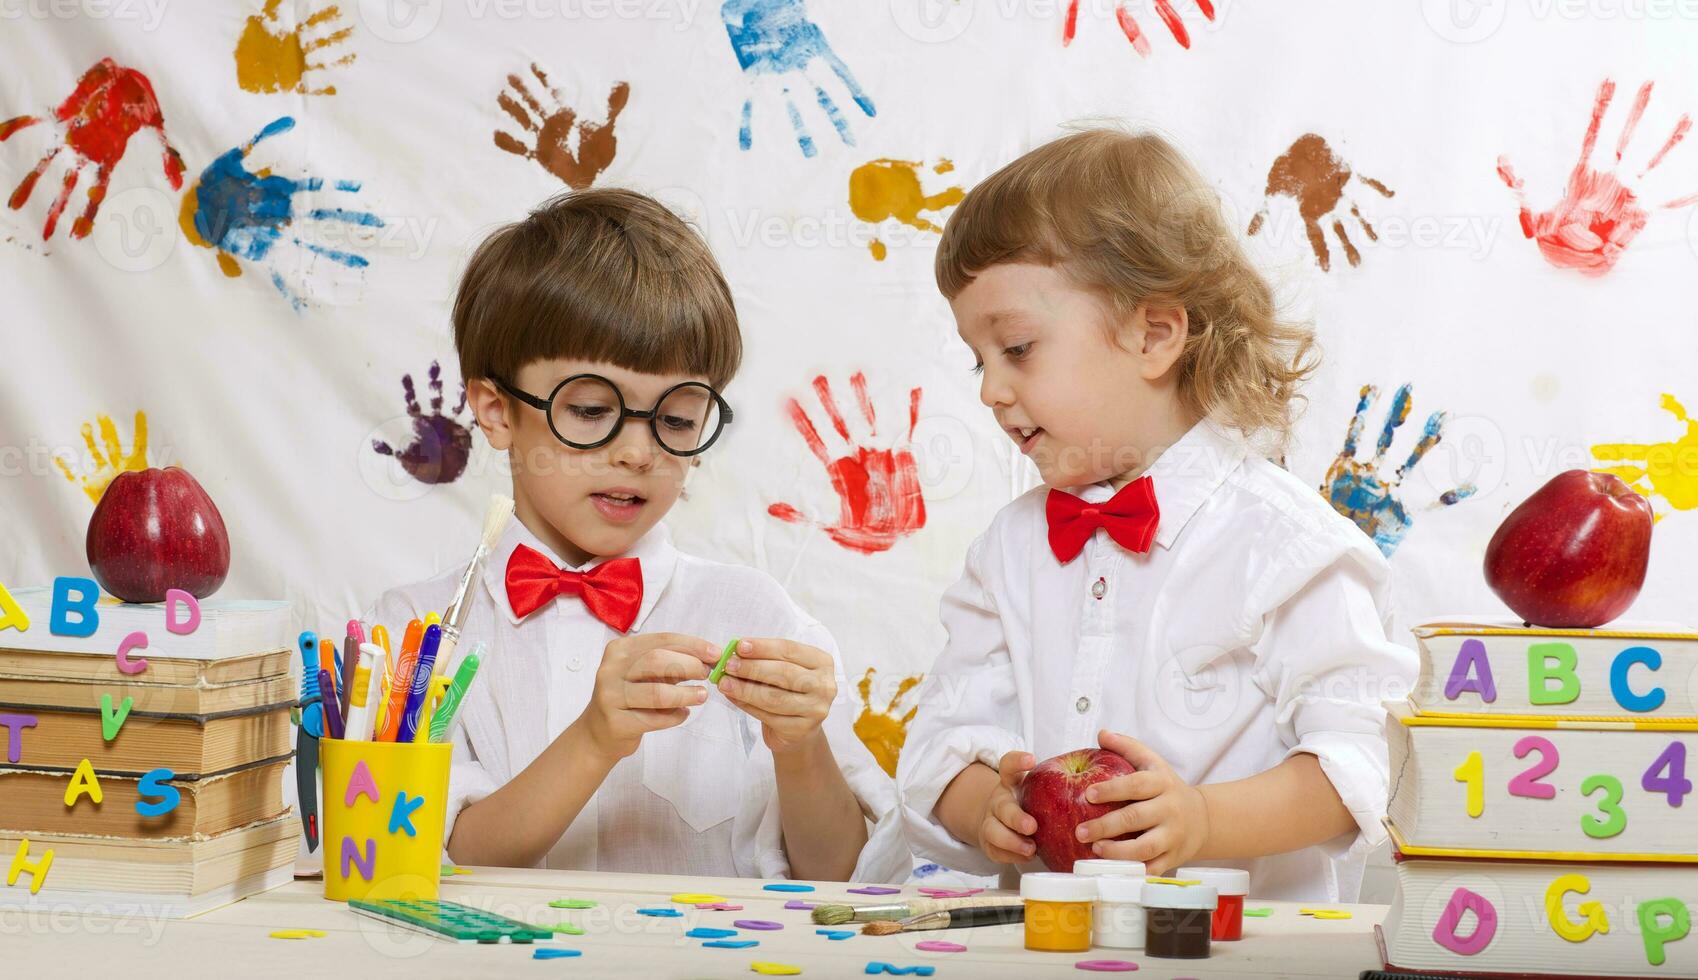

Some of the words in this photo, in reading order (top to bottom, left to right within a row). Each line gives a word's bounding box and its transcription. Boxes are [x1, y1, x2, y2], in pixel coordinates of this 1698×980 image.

[50, 576, 100, 638] B
[165, 588, 202, 636] D
[116, 631, 149, 675] C
[1444, 639, 1497, 703] A
[1527, 642, 1581, 705] B
[1610, 646, 1666, 712] C
[0, 714, 38, 763] T
[101, 693, 133, 742] V
[63, 757, 104, 807] A
[135, 768, 181, 817] S
[345, 760, 380, 807] A
[1453, 751, 1485, 818] 1
[1507, 736, 1560, 800] 2
[1580, 774, 1627, 839] 3
[1641, 740, 1693, 807] 4
[389, 791, 425, 837] K
[7, 838, 55, 894] H
[341, 836, 376, 881] N
[1432, 887, 1498, 956] D
[1545, 872, 1610, 943] G
[1637, 897, 1691, 966] P
